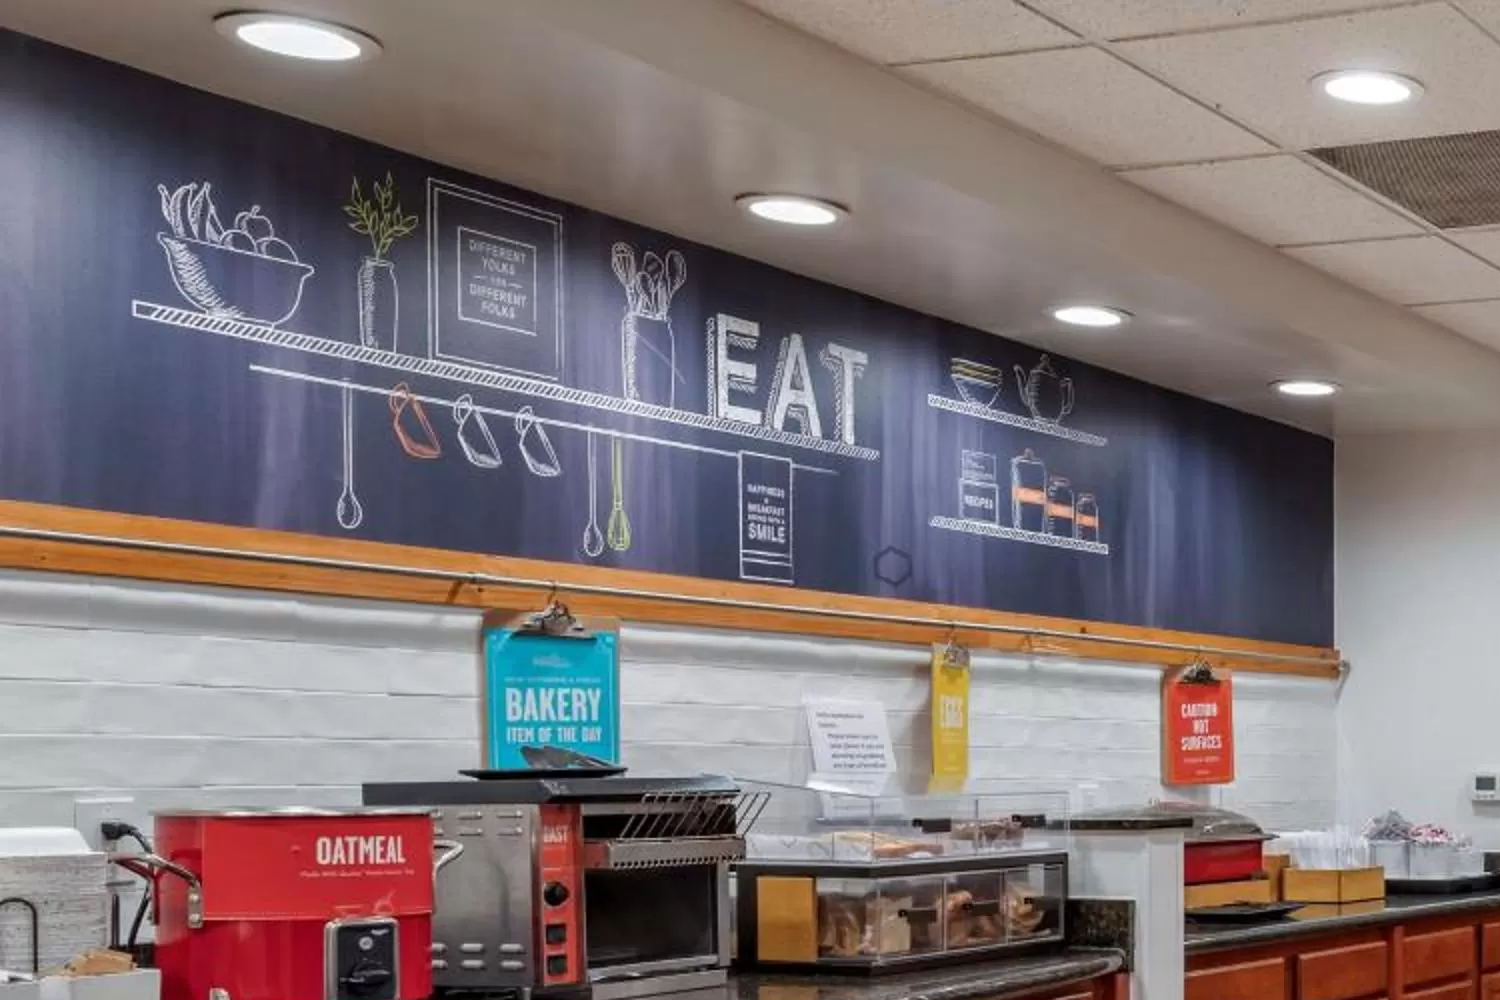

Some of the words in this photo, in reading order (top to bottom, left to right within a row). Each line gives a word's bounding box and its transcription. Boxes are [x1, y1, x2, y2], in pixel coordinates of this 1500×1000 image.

[468, 239, 527, 265] DIFFERENT
[481, 255, 516, 277] YOLKS
[468, 283, 527, 308] DIFFERENT
[481, 300, 516, 319] FOLKS
[706, 312, 869, 446] EAT
[748, 522, 786, 544] SMILE
[504, 687, 602, 722] BAKERY
[506, 727, 535, 744] ITEM
[538, 727, 552, 743] OF
[557, 726, 577, 743] THE
[581, 726, 603, 743] DAY
[316, 835, 406, 866] OATMEAL
